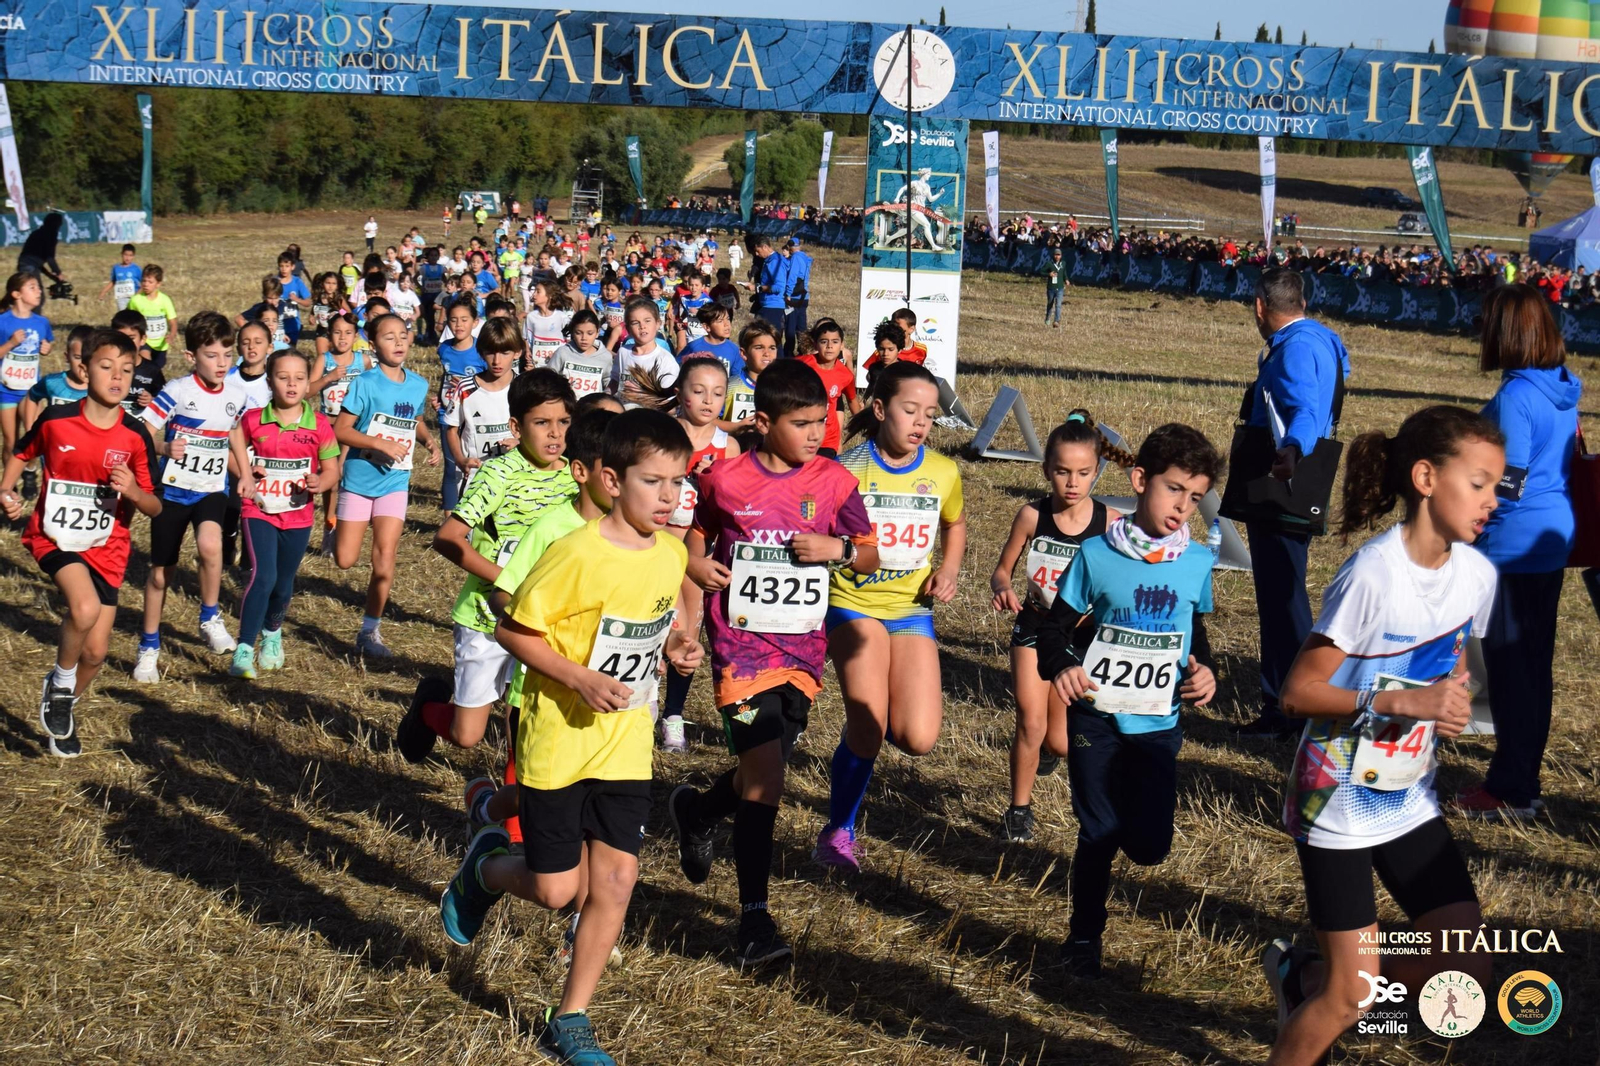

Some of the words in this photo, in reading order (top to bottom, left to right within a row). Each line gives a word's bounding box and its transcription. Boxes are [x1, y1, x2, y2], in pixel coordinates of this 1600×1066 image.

[90, 5, 262, 66] XLIII
[263, 12, 395, 50] CROSS
[262, 48, 442, 73] INTERNACIONAL
[453, 10, 773, 92] ITÁLICA
[89, 65, 248, 87] INTERNATIONAL
[252, 70, 313, 90] CROSS
[315, 72, 410, 93] COUNTRY
[1000, 42, 1169, 106] XLIII
[1173, 52, 1306, 91] CROSS
[1172, 89, 1351, 116] INTERNACIONAL
[999, 101, 1158, 127] INTERNATIONAL
[1161, 110, 1222, 130] CROSS
[1224, 114, 1319, 136] COUNTRY
[919, 136, 955, 147] Sevilla
[535, 350, 554, 360] 43
[5, 366, 36, 380] 4460
[327, 390, 346, 404] 43
[489, 423, 510, 433] ITÁLIC
[482, 441, 506, 457] 41
[174, 453, 225, 475] 4143
[268, 459, 298, 469] ITÁLICA
[70, 485, 96, 497] ITÁLI
[880, 495, 920, 508] ITÁLICA
[51, 506, 112, 531] 4256
[760, 548, 791, 562] ITÁLI
[738, 575, 822, 606] 4325
[1032, 565, 1063, 592] 45
[1117, 632, 1162, 647] ITÁLICA
[1382, 632, 1418, 644] BORDISPORT
[1090, 657, 1172, 689] 4206
[1372, 723, 1427, 759] 44
